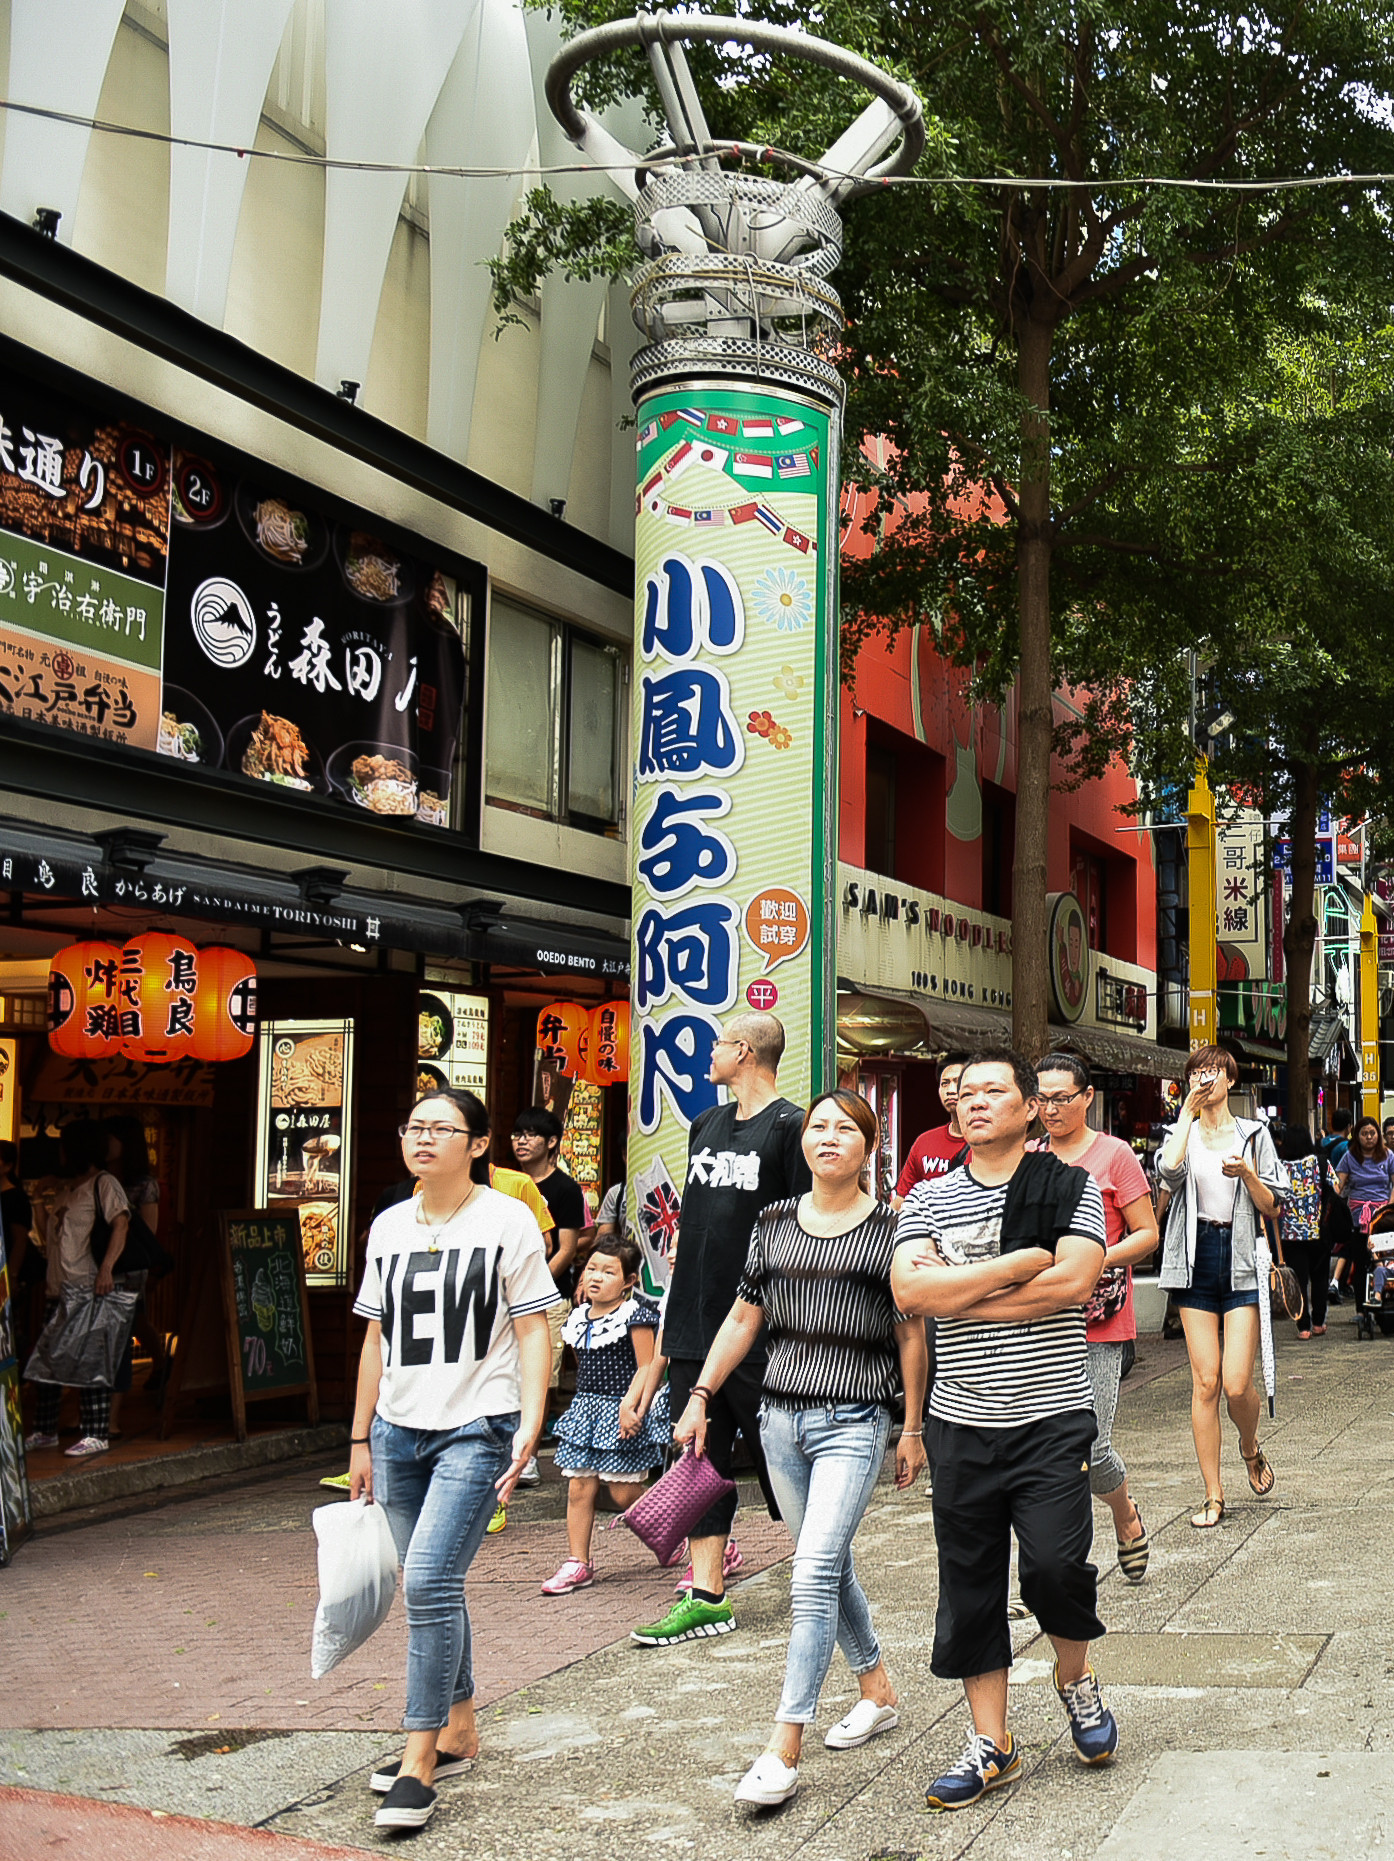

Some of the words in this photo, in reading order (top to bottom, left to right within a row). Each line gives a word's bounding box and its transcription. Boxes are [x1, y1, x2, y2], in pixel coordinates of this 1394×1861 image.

[131, 449, 156, 482] 1F
[188, 473, 212, 507] 2F
[264, 601, 283, 679] うどん
[115, 879, 187, 906] からあげ
[193, 894, 271, 915] SANDAIME
[272, 905, 358, 931] TORIYOSHI
[759, 899, 797, 922] 歡迎
[847, 882, 921, 926] SAM'S
[928, 907, 1013, 955] NOODLE
[760, 924, 797, 946] 試穿
[537, 950, 566, 965] OOEDO
[567, 954, 596, 969] BENTO
[120, 949, 142, 1038] 三代目
[165, 950, 197, 1036] 鳥良
[750, 984, 775, 1007] 平
[943, 978, 974, 1000] HONG
[1193, 1008, 1206, 1027] H
[597, 1008, 620, 1073] 自慢の味
[1365, 1052, 1375, 1065] H
[230, 1223, 287, 1250] 新品上市
[271, 1257, 300, 1357] 北海道鮮奶
[376, 1245, 504, 1367] NEW
